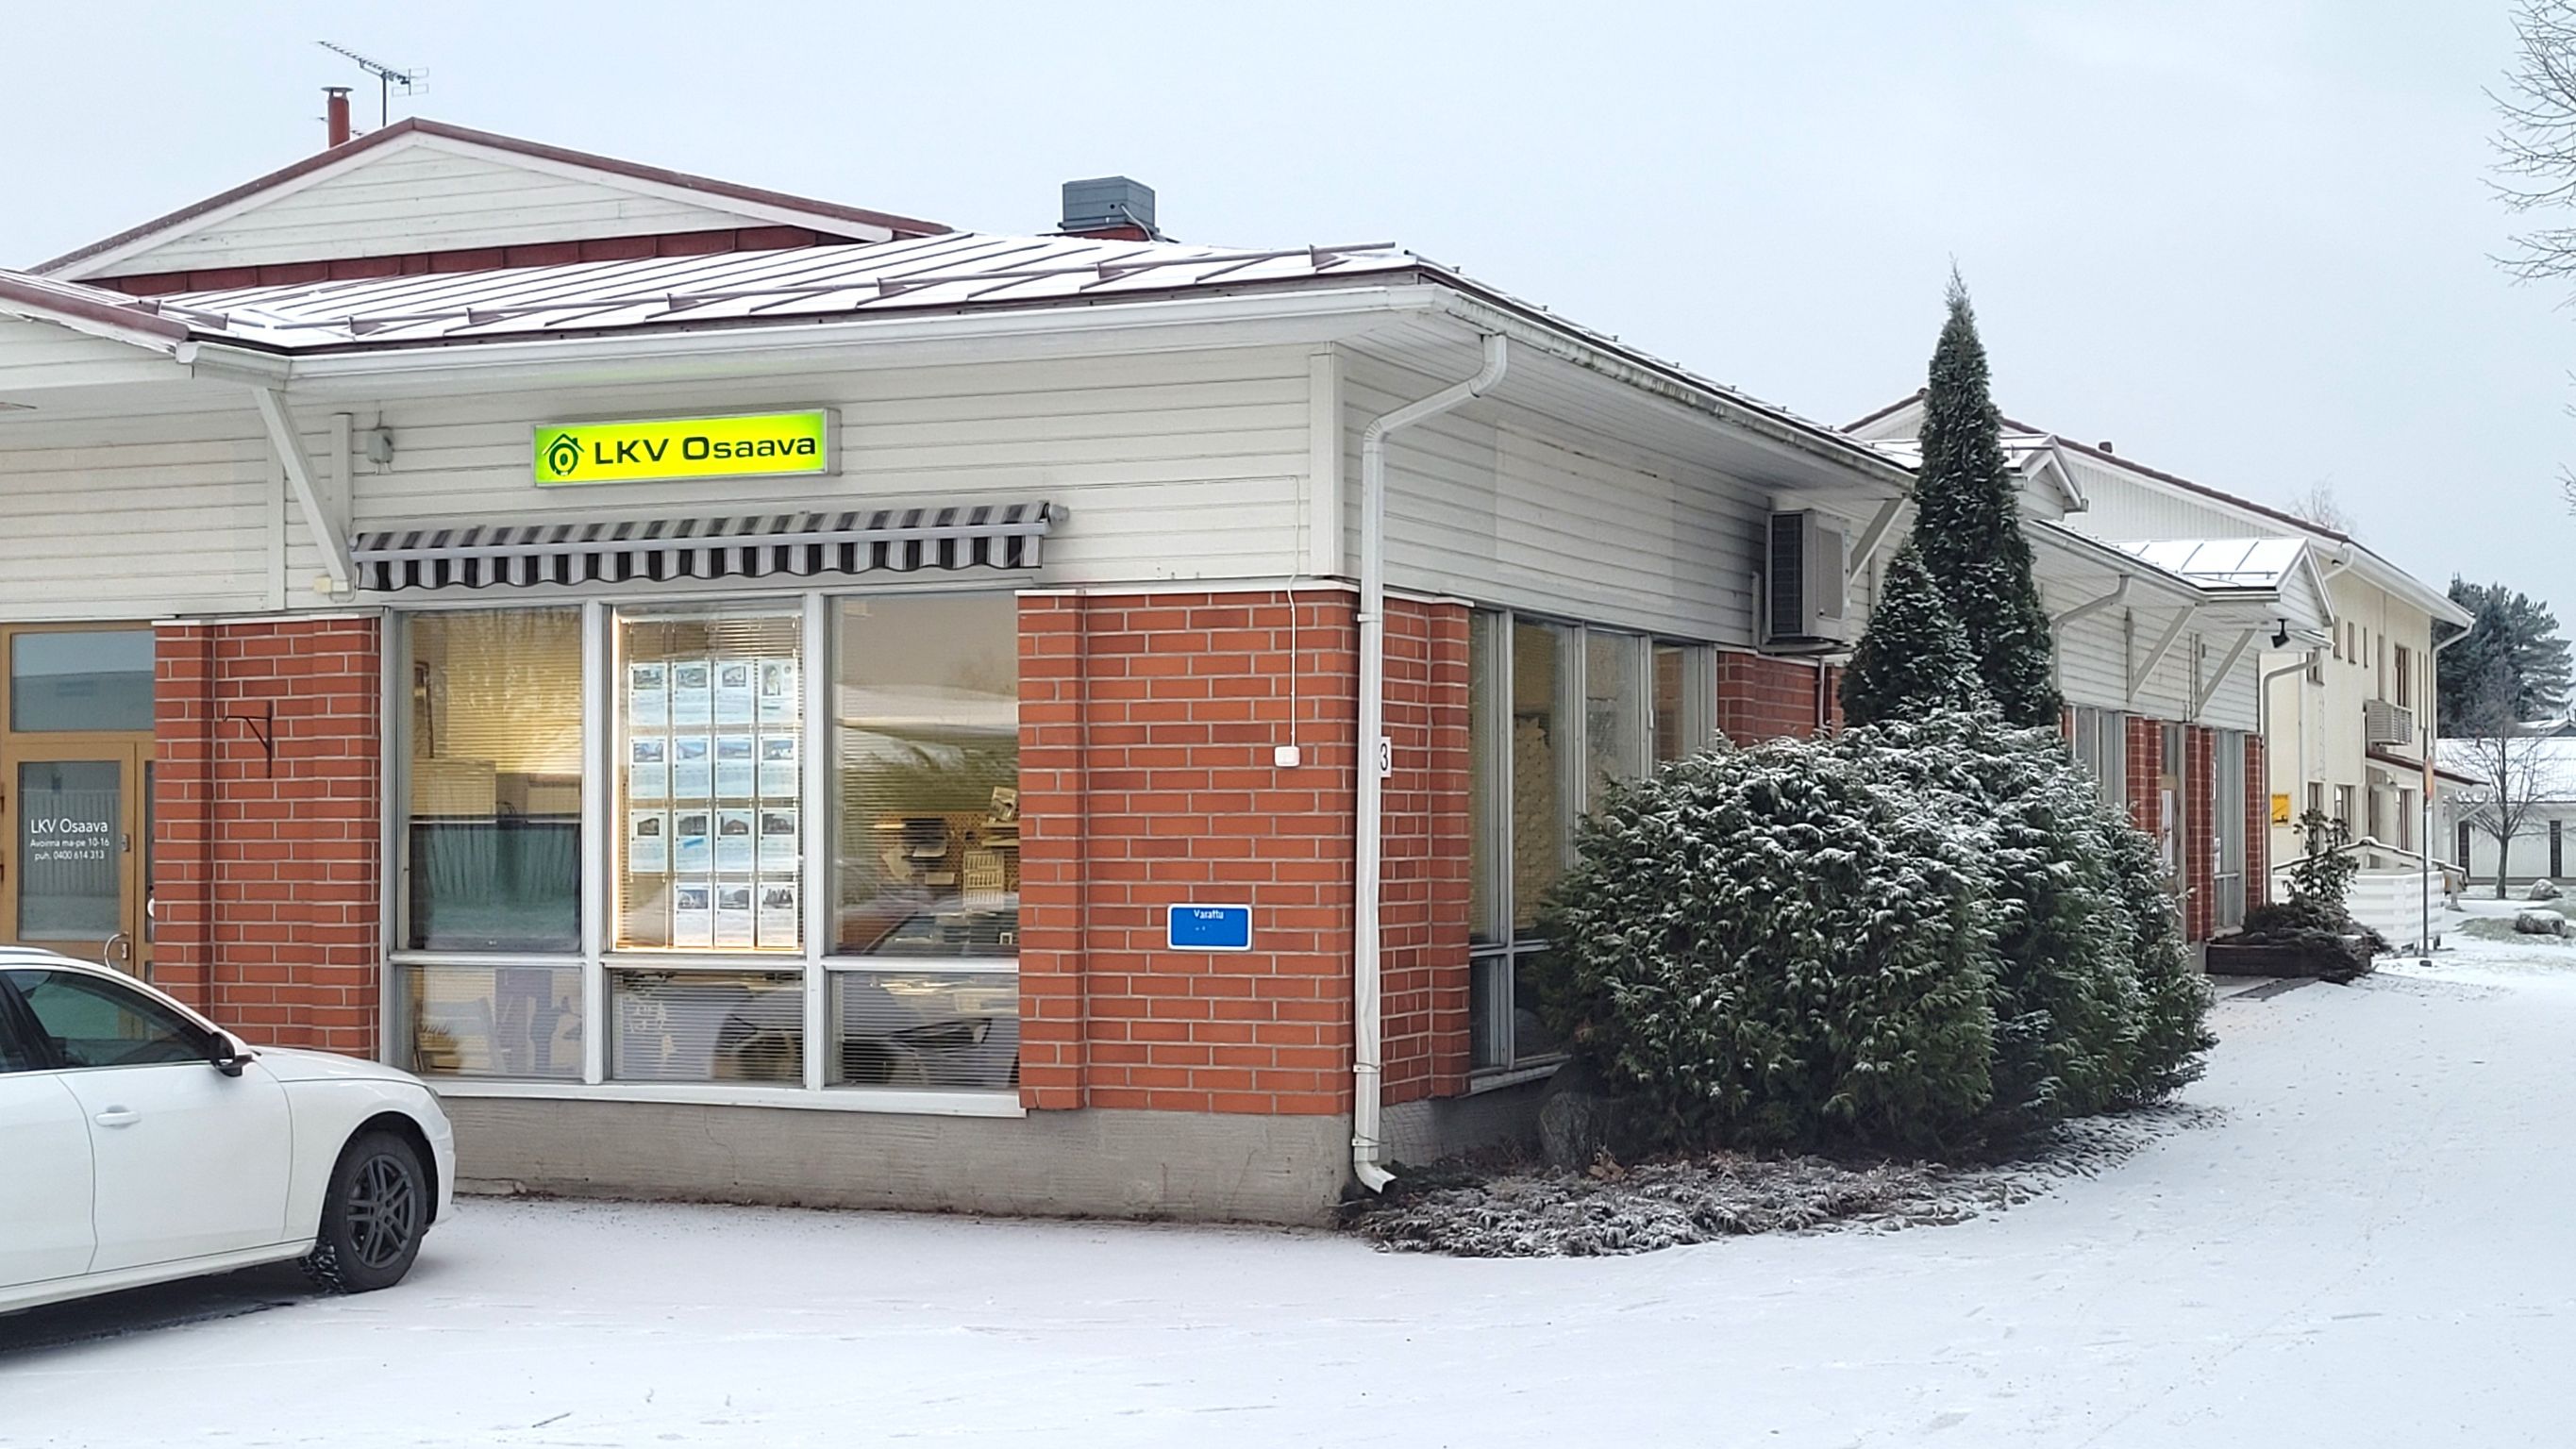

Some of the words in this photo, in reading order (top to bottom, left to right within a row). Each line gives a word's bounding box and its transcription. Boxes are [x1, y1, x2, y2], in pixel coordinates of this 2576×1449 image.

[594, 439, 669, 465] LKV
[683, 436, 816, 460] Osaava
[30, 818, 57, 834] LKV
[59, 818, 109, 833] Osaava
[30, 839, 60, 848] Avoinna
[61, 840, 87, 849] ma-pe
[88, 837, 110, 847] 10-16
[52, 850, 73, 860] 0400
[74, 850, 89, 859] 614
[90, 850, 105, 859] 313
